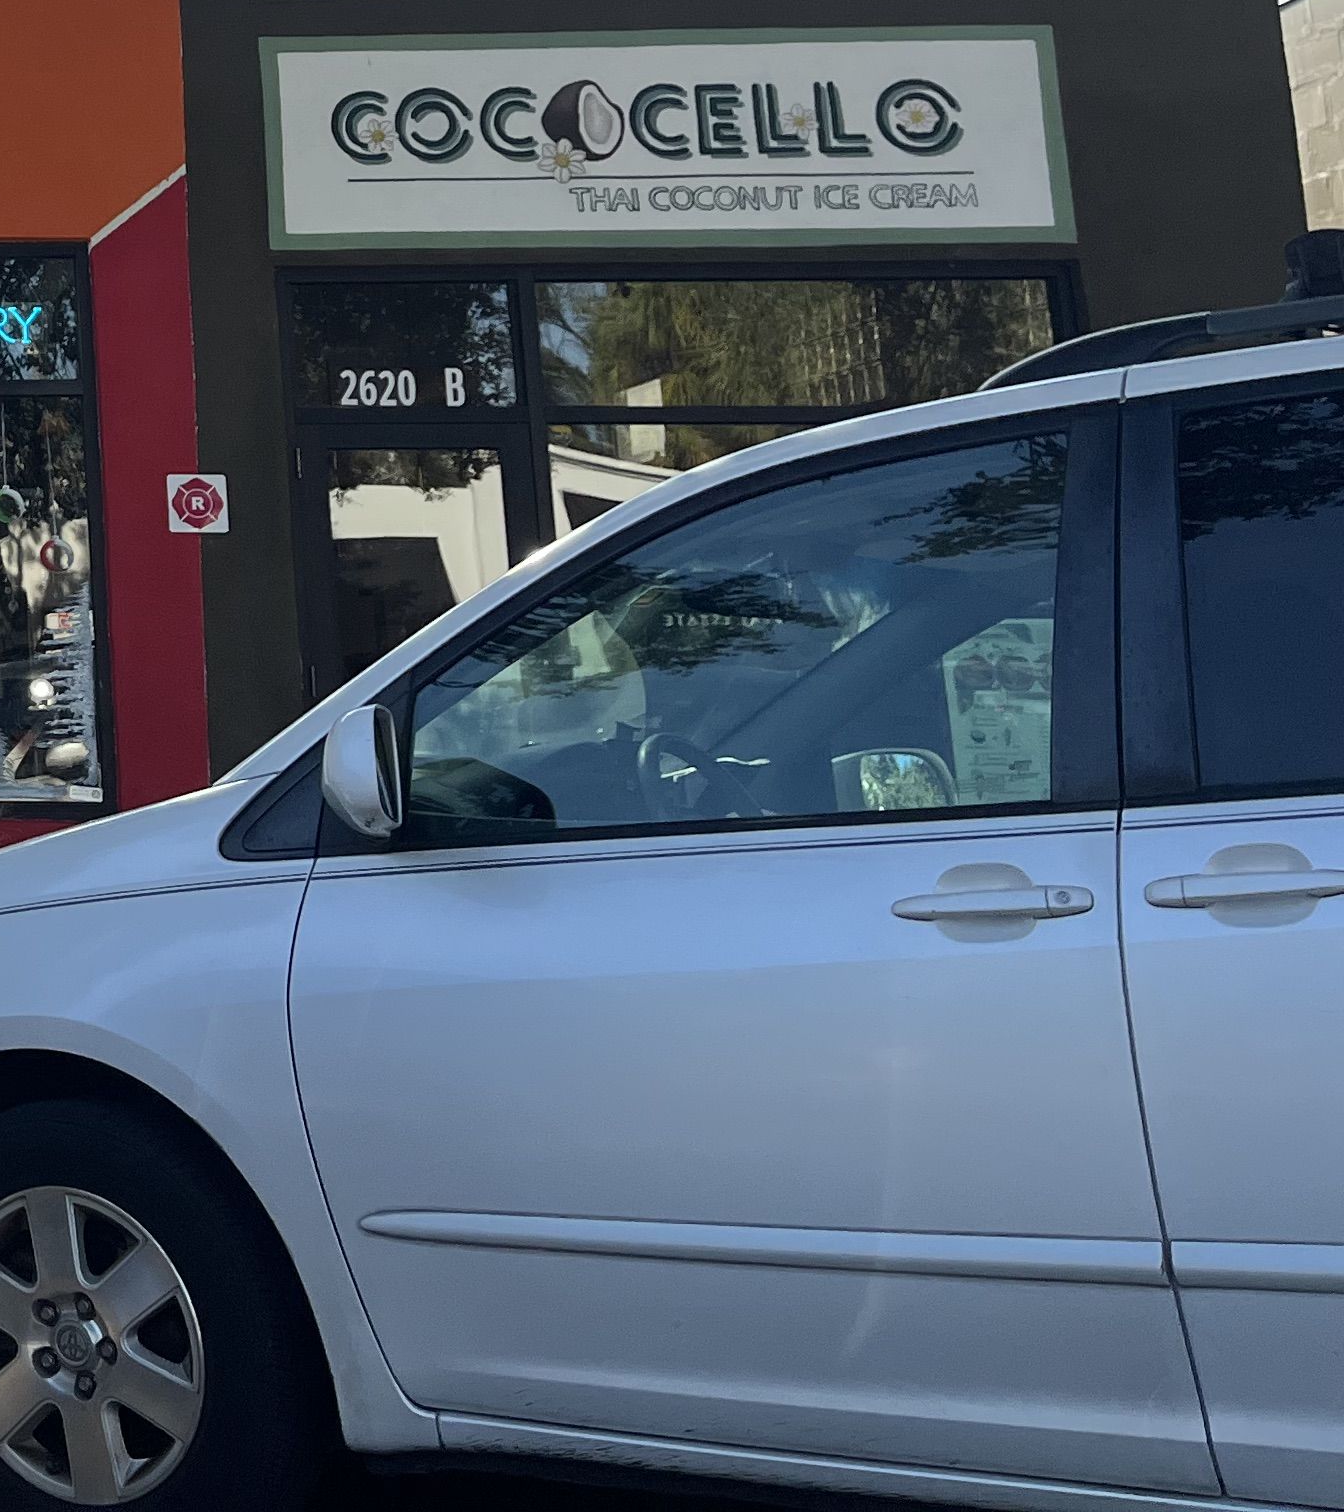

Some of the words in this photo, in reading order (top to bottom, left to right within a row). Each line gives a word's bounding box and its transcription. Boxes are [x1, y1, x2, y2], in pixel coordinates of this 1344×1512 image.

[569, 187, 640, 212] THAI
[649, 185, 802, 211] COCONUT
[814, 184, 860, 210] ICE
[869, 183, 978, 209] CREAM
[339, 369, 417, 406] 2620
[444, 367, 466, 407] B
[192, 496, 205, 511] R
